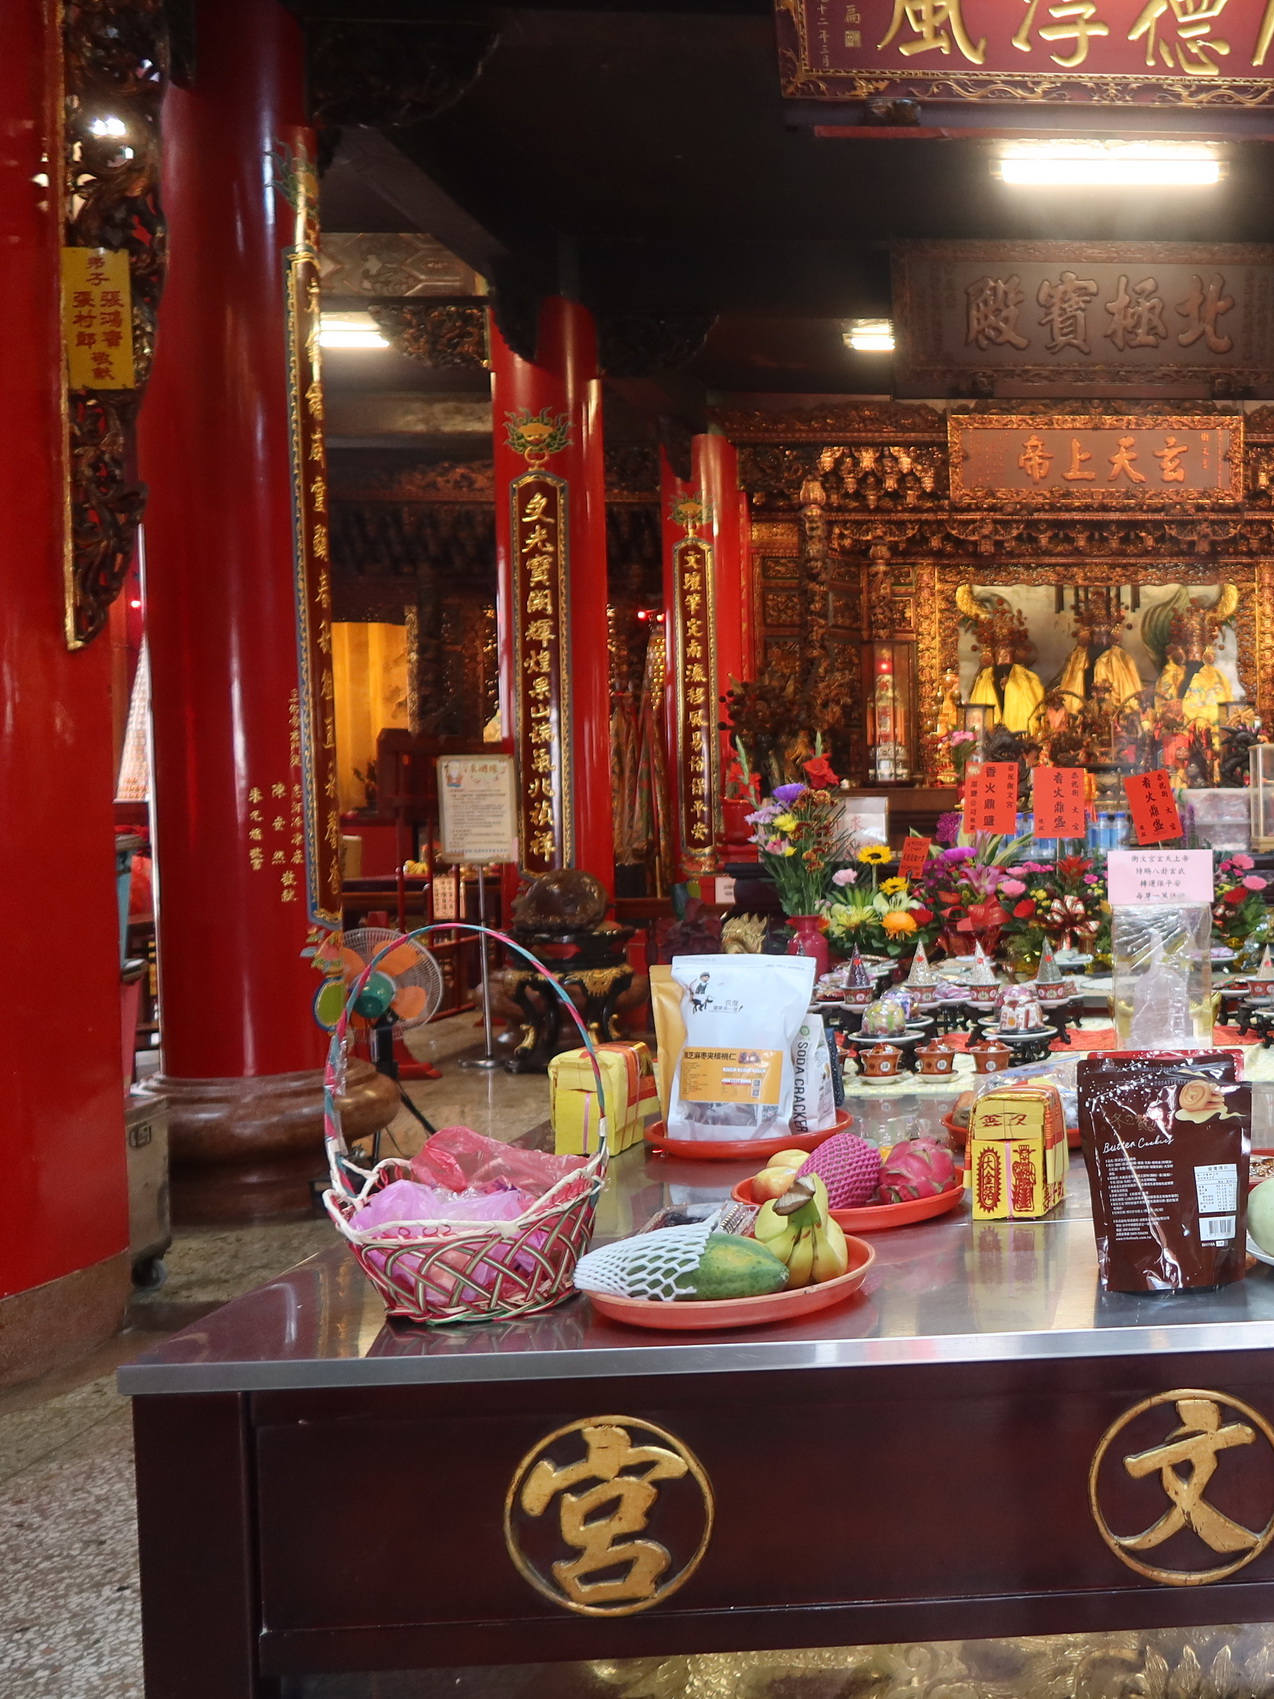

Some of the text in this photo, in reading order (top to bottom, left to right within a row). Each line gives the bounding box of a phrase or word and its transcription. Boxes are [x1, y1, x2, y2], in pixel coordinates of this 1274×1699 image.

[1016, 433, 1189, 484] 玄天上帝
[983, 766, 997, 827] 香火鼎盛
[1052, 771, 1066, 829] 香火鼎盛
[1142, 776, 1165, 833] 香火鼎盛
[1131, 854, 1189, 863] 衡文宮玄天上帝
[793, 1041, 809, 1132] SODA CRACKER
[1102, 1140, 1136, 1154] Butter
[1114, 1399, 1262, 1556] 文
[519, 1424, 690, 1606] 宮
